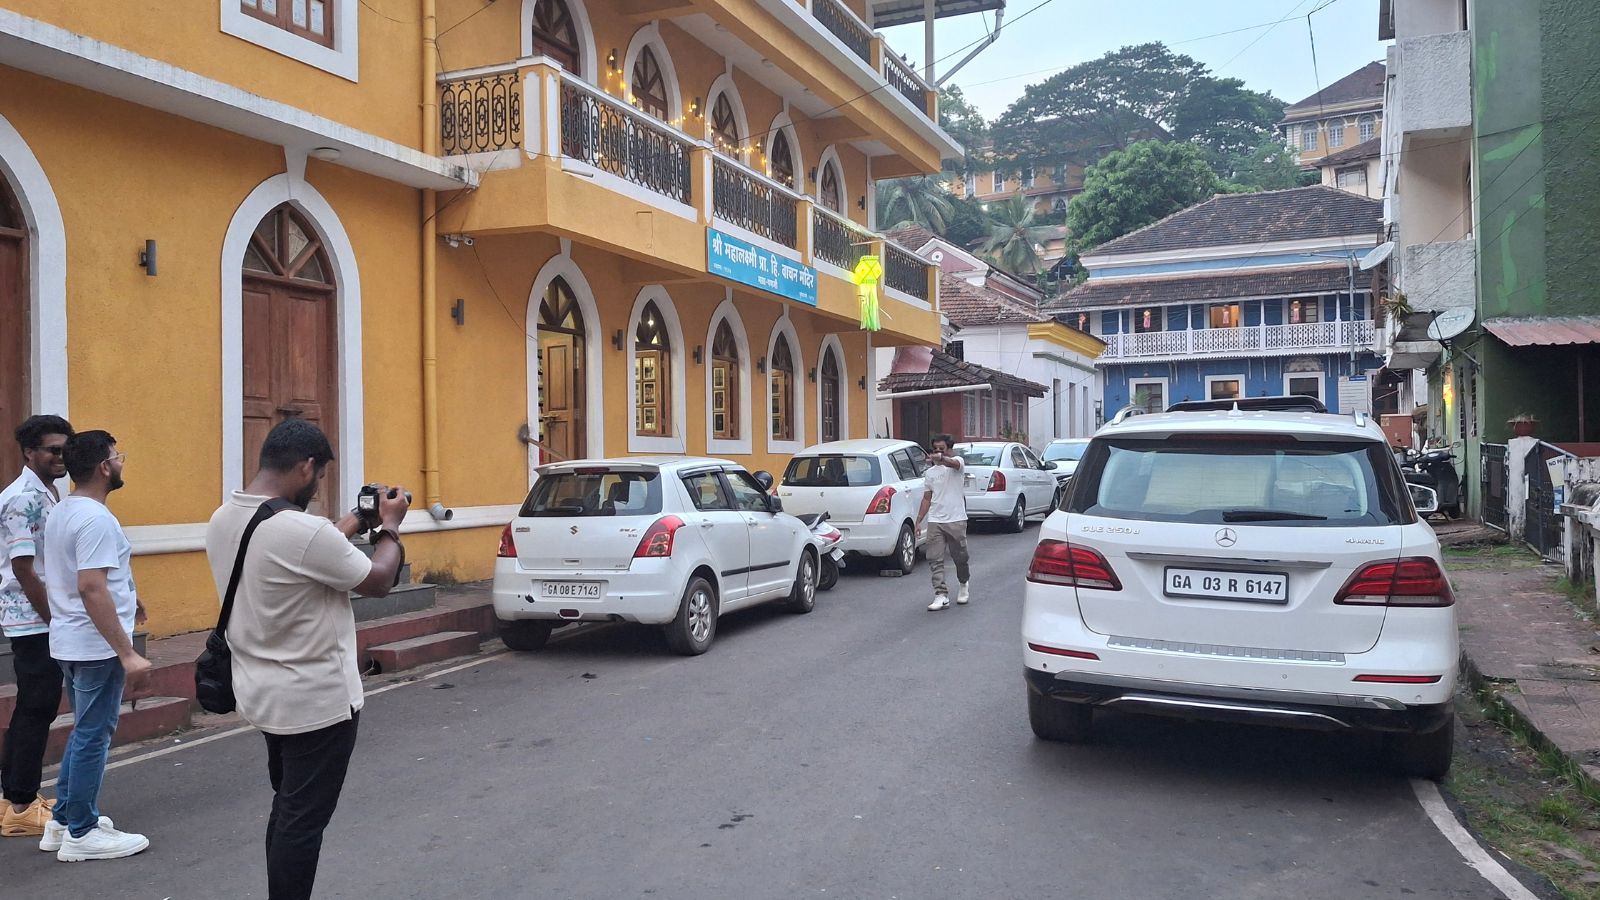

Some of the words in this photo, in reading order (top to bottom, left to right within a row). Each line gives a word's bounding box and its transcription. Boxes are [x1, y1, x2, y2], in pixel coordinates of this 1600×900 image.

[712, 233, 722, 256] श्री
[724, 243, 757, 268] महालक्ष्मी
[759, 256, 769, 272] प्रा.
[770, 254, 780, 277] हि.
[782, 264, 798, 282] वाचन
[799, 265, 814, 288] मंदिर
[547, 585, 558, 595] GA
[559, 585, 570, 595] 08
[571, 585, 576, 595] E
[577, 585, 598, 596] 7143
[1172, 574, 1192, 589] GA
[1203, 576, 1221, 591] 03
[1228, 578, 1238, 593] R
[1245, 579, 1282, 595] 6147
